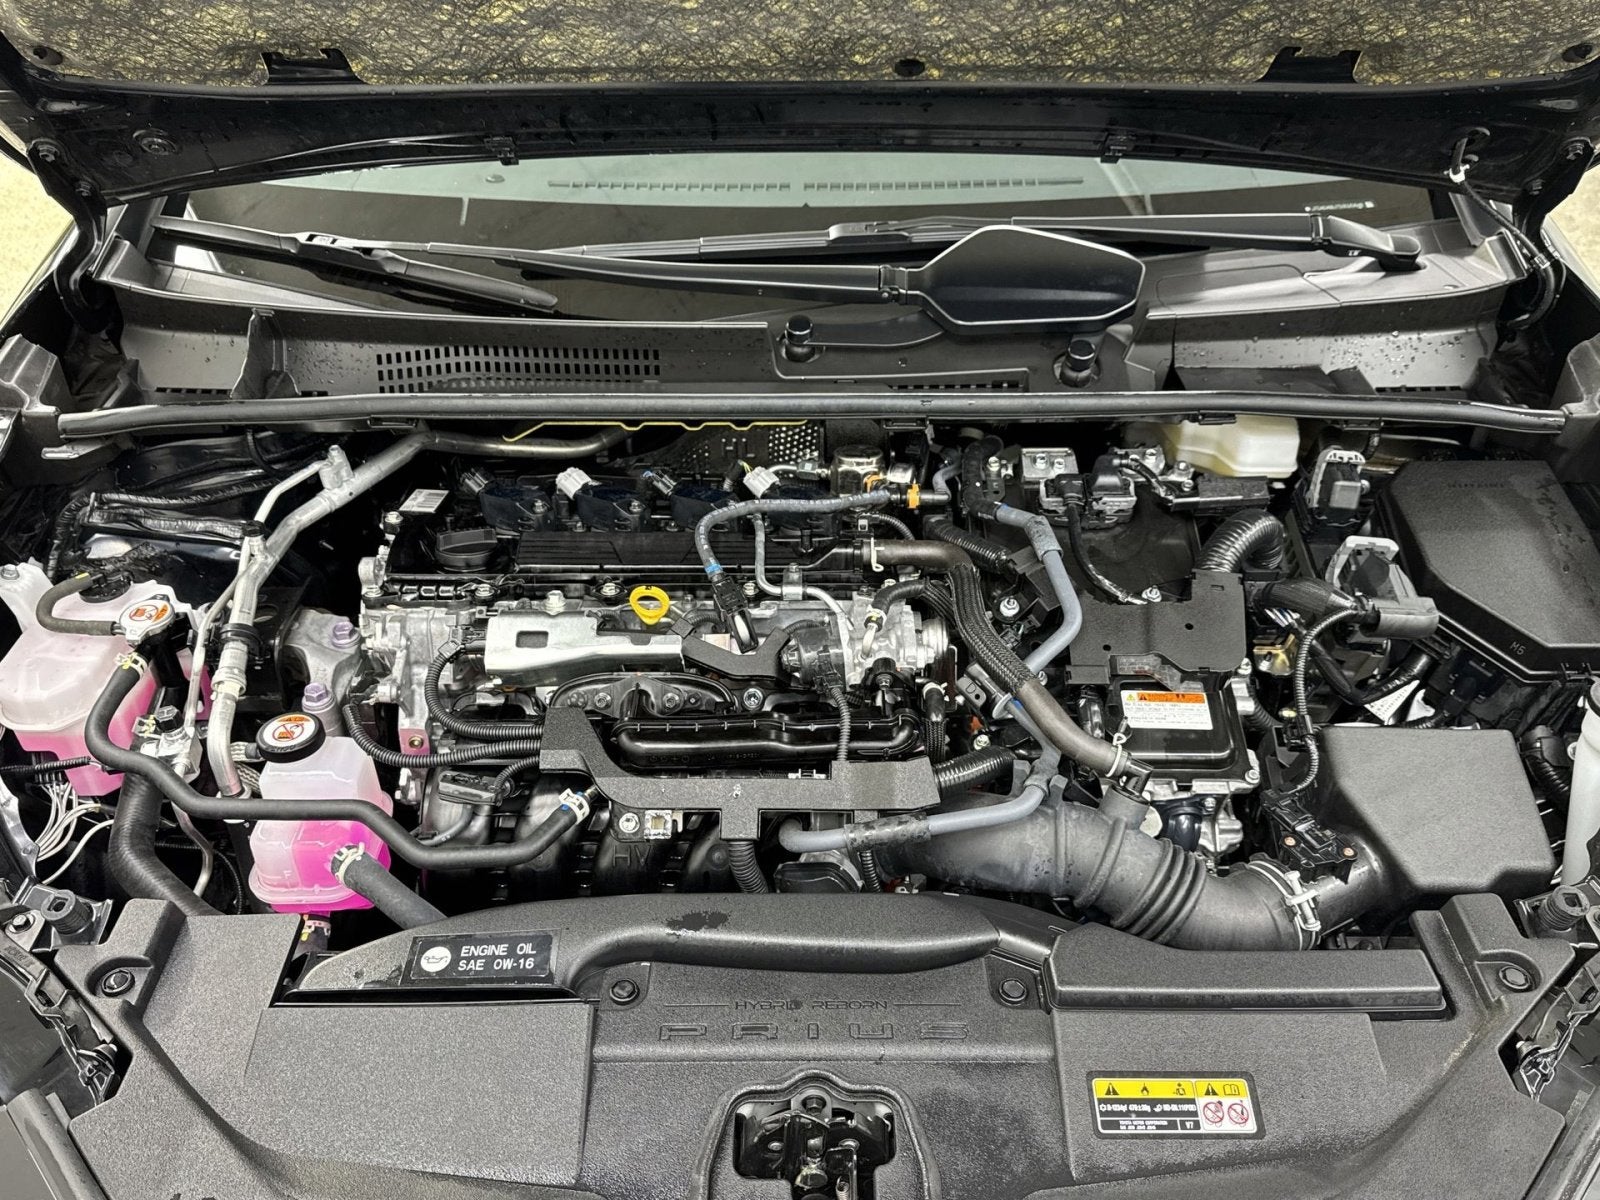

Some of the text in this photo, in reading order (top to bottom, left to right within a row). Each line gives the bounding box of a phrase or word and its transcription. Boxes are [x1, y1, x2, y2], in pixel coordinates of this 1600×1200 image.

[612, 844, 652, 867] HV
[460, 942, 537, 957] ENGINE OIL
[457, 957, 535, 971] SAE 0W-16
[812, 1000, 888, 1010] REBORN
[658, 1022, 969, 1041] PRIUS
